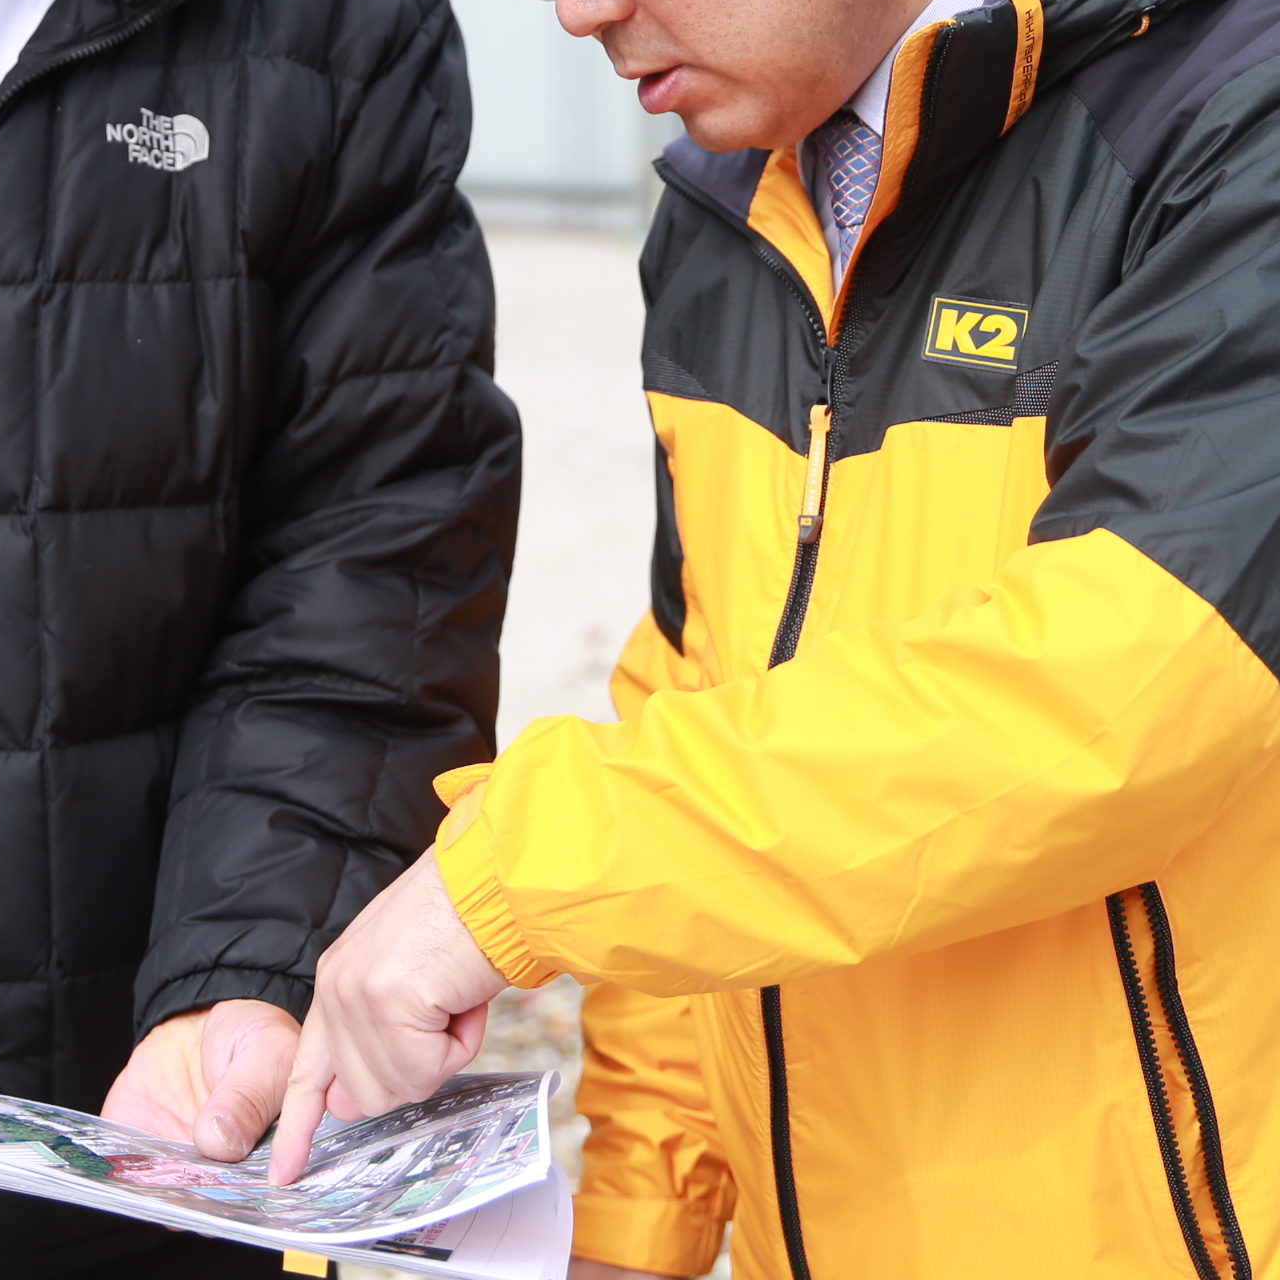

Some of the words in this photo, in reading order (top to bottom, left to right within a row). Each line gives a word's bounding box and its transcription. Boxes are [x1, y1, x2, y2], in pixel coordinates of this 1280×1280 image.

[140, 107, 173, 134] THE
[106, 123, 174, 152] NORTH
[128, 143, 176, 171] FACE
[935, 308, 1018, 360] K2
